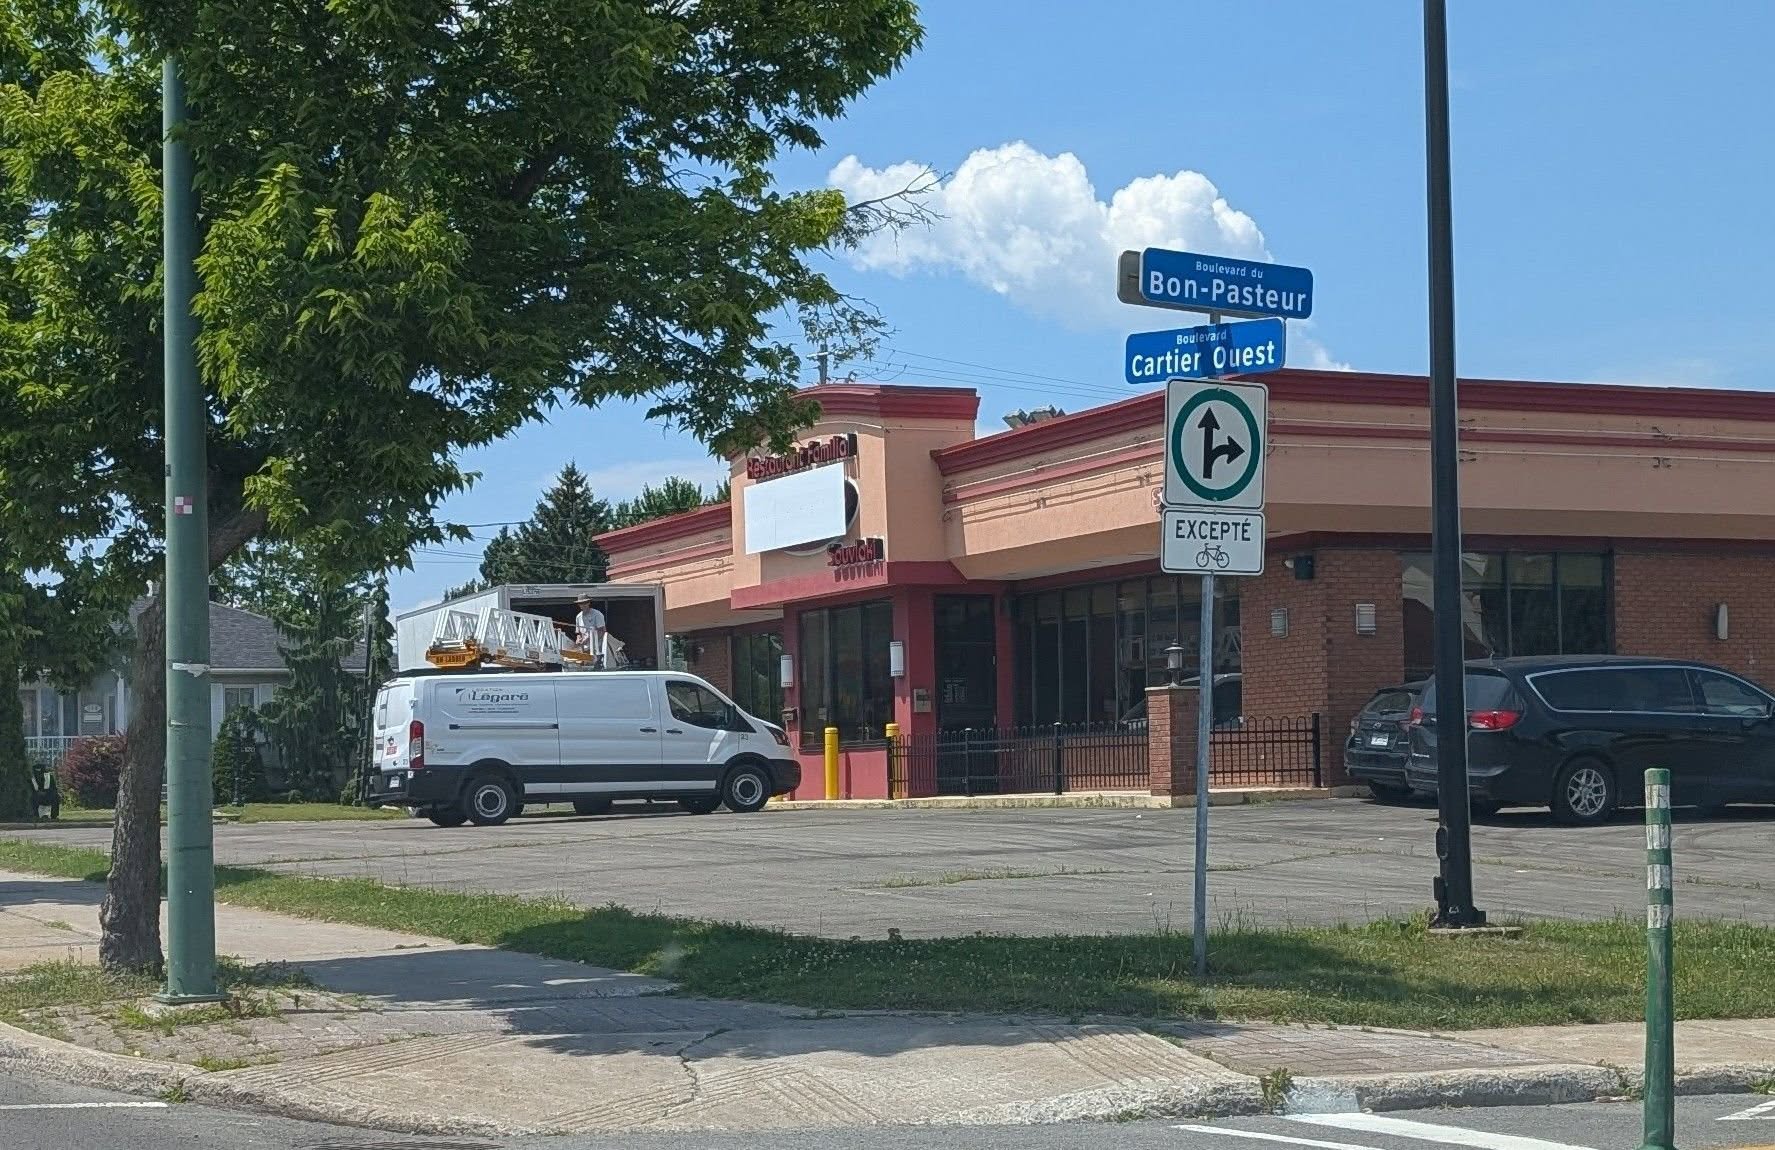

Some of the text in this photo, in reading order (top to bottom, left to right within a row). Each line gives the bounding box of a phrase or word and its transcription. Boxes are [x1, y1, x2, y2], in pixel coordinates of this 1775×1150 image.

[1195, 261, 1264, 279] Boulevard du
[1149, 271, 1307, 312] Bon-Pasteur
[1176, 329, 1227, 345] Boulevard
[1131, 340, 1275, 377] Cartier Ouest
[1175, 517, 1252, 542] EXCEPTÉ
